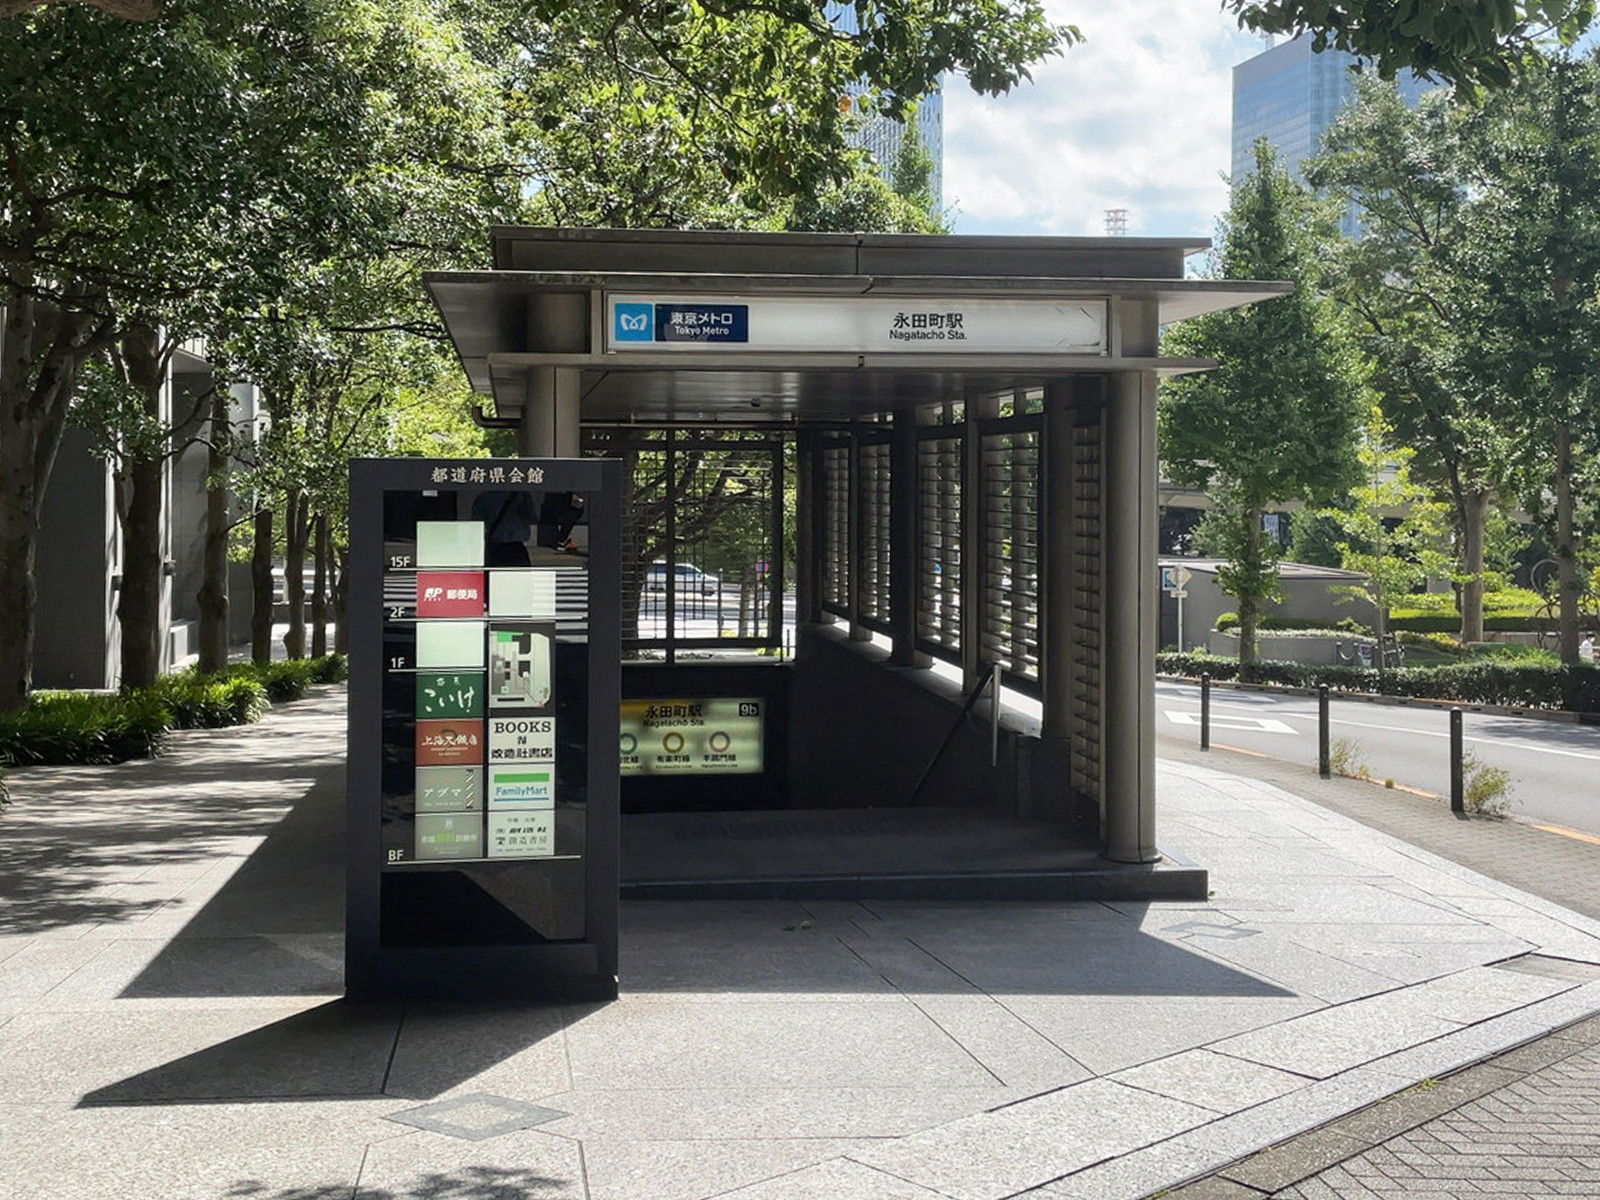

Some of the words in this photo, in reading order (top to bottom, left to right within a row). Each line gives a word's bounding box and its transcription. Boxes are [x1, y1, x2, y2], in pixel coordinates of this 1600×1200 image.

[670, 312, 734, 325] 東京メトロ
[893, 312, 964, 329] 永田町駅
[675, 326, 700, 337] Tokyo
[702, 326, 730, 335] Metro
[947, 329, 967, 340] Sta.
[430, 467, 546, 484] 都道府県会館
[390, 556, 411, 567] 15F
[447, 588, 478, 600] 郵便局
[390, 607, 405, 618] 2F
[391, 658, 405, 668] 1F
[424, 686, 475, 712] こいけ
[645, 704, 703, 719] 永田町駅
[740, 704, 757, 715] 9b
[494, 721, 552, 734] BOOKS
[495, 786, 548, 797] FamilyMart
[388, 850, 404, 861] BF
